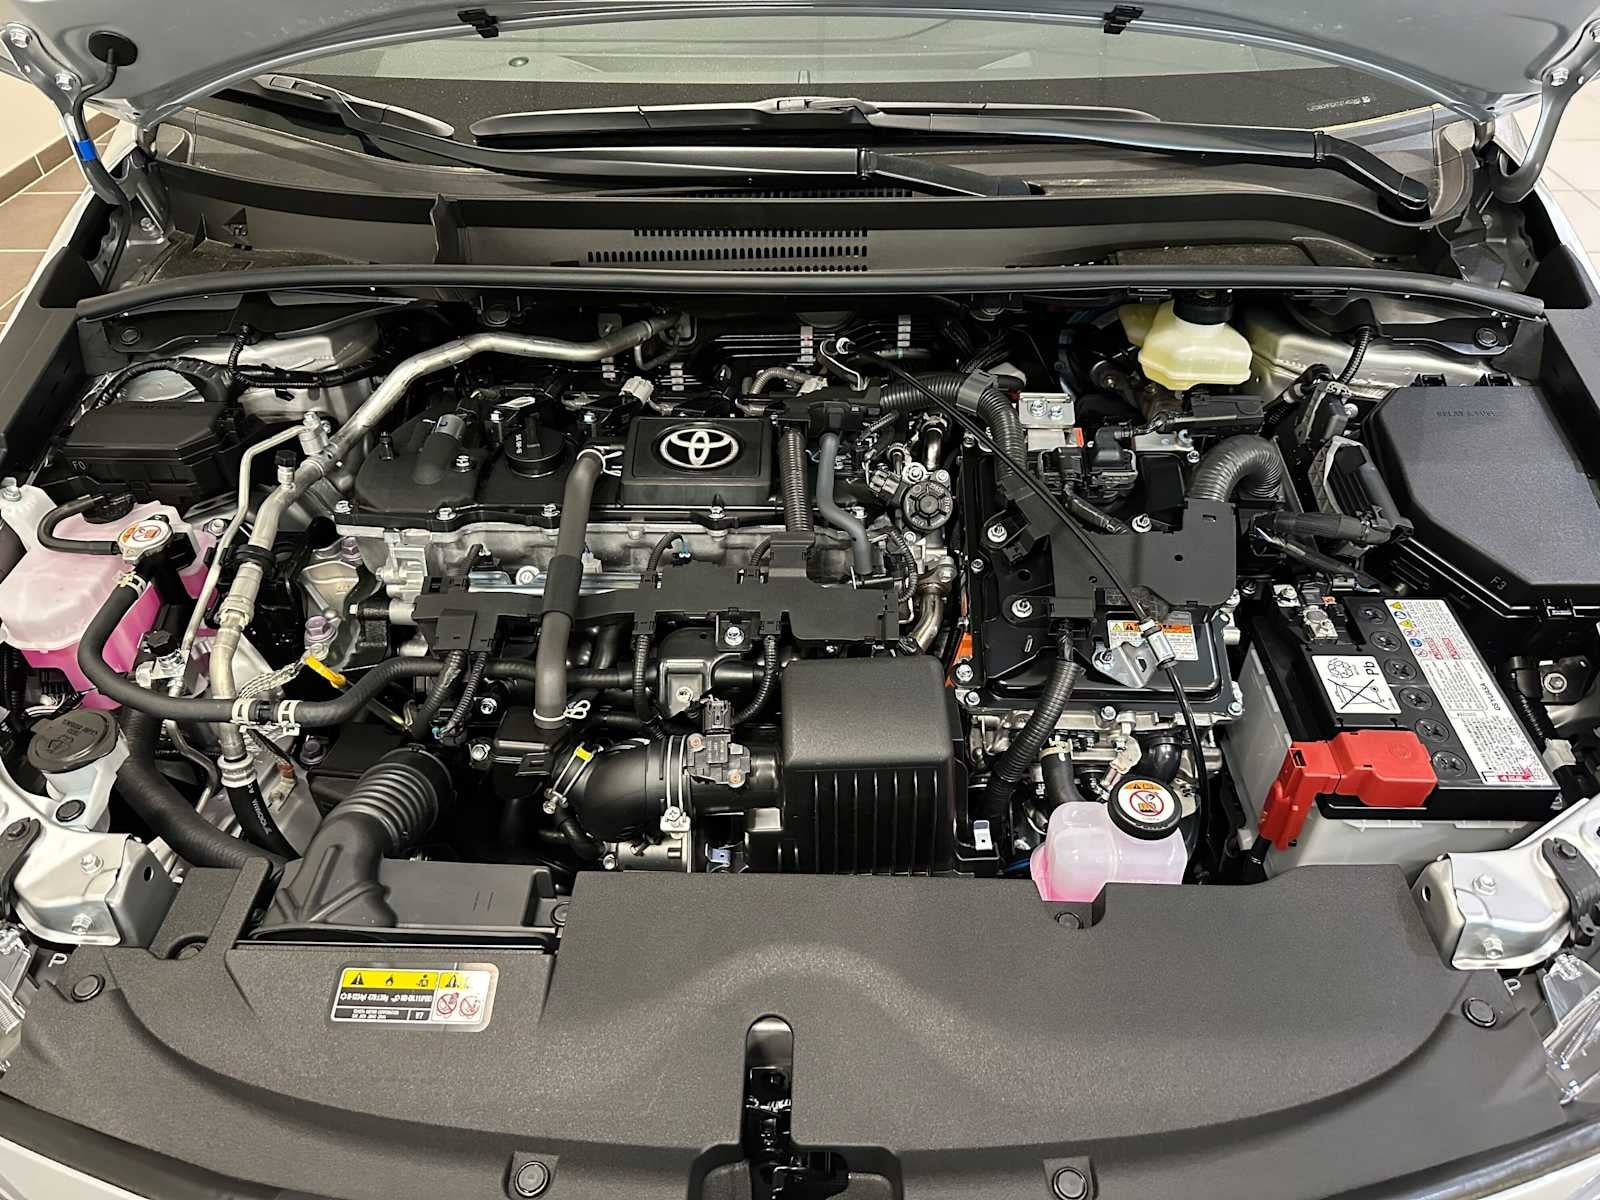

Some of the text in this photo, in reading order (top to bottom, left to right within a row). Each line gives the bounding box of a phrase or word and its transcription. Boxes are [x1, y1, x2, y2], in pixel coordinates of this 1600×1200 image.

[1490, 575, 1508, 590] F3
[1363, 661, 1379, 676] Pb
[47, 952, 68, 968] P
[1503, 978, 1522, 997] P
